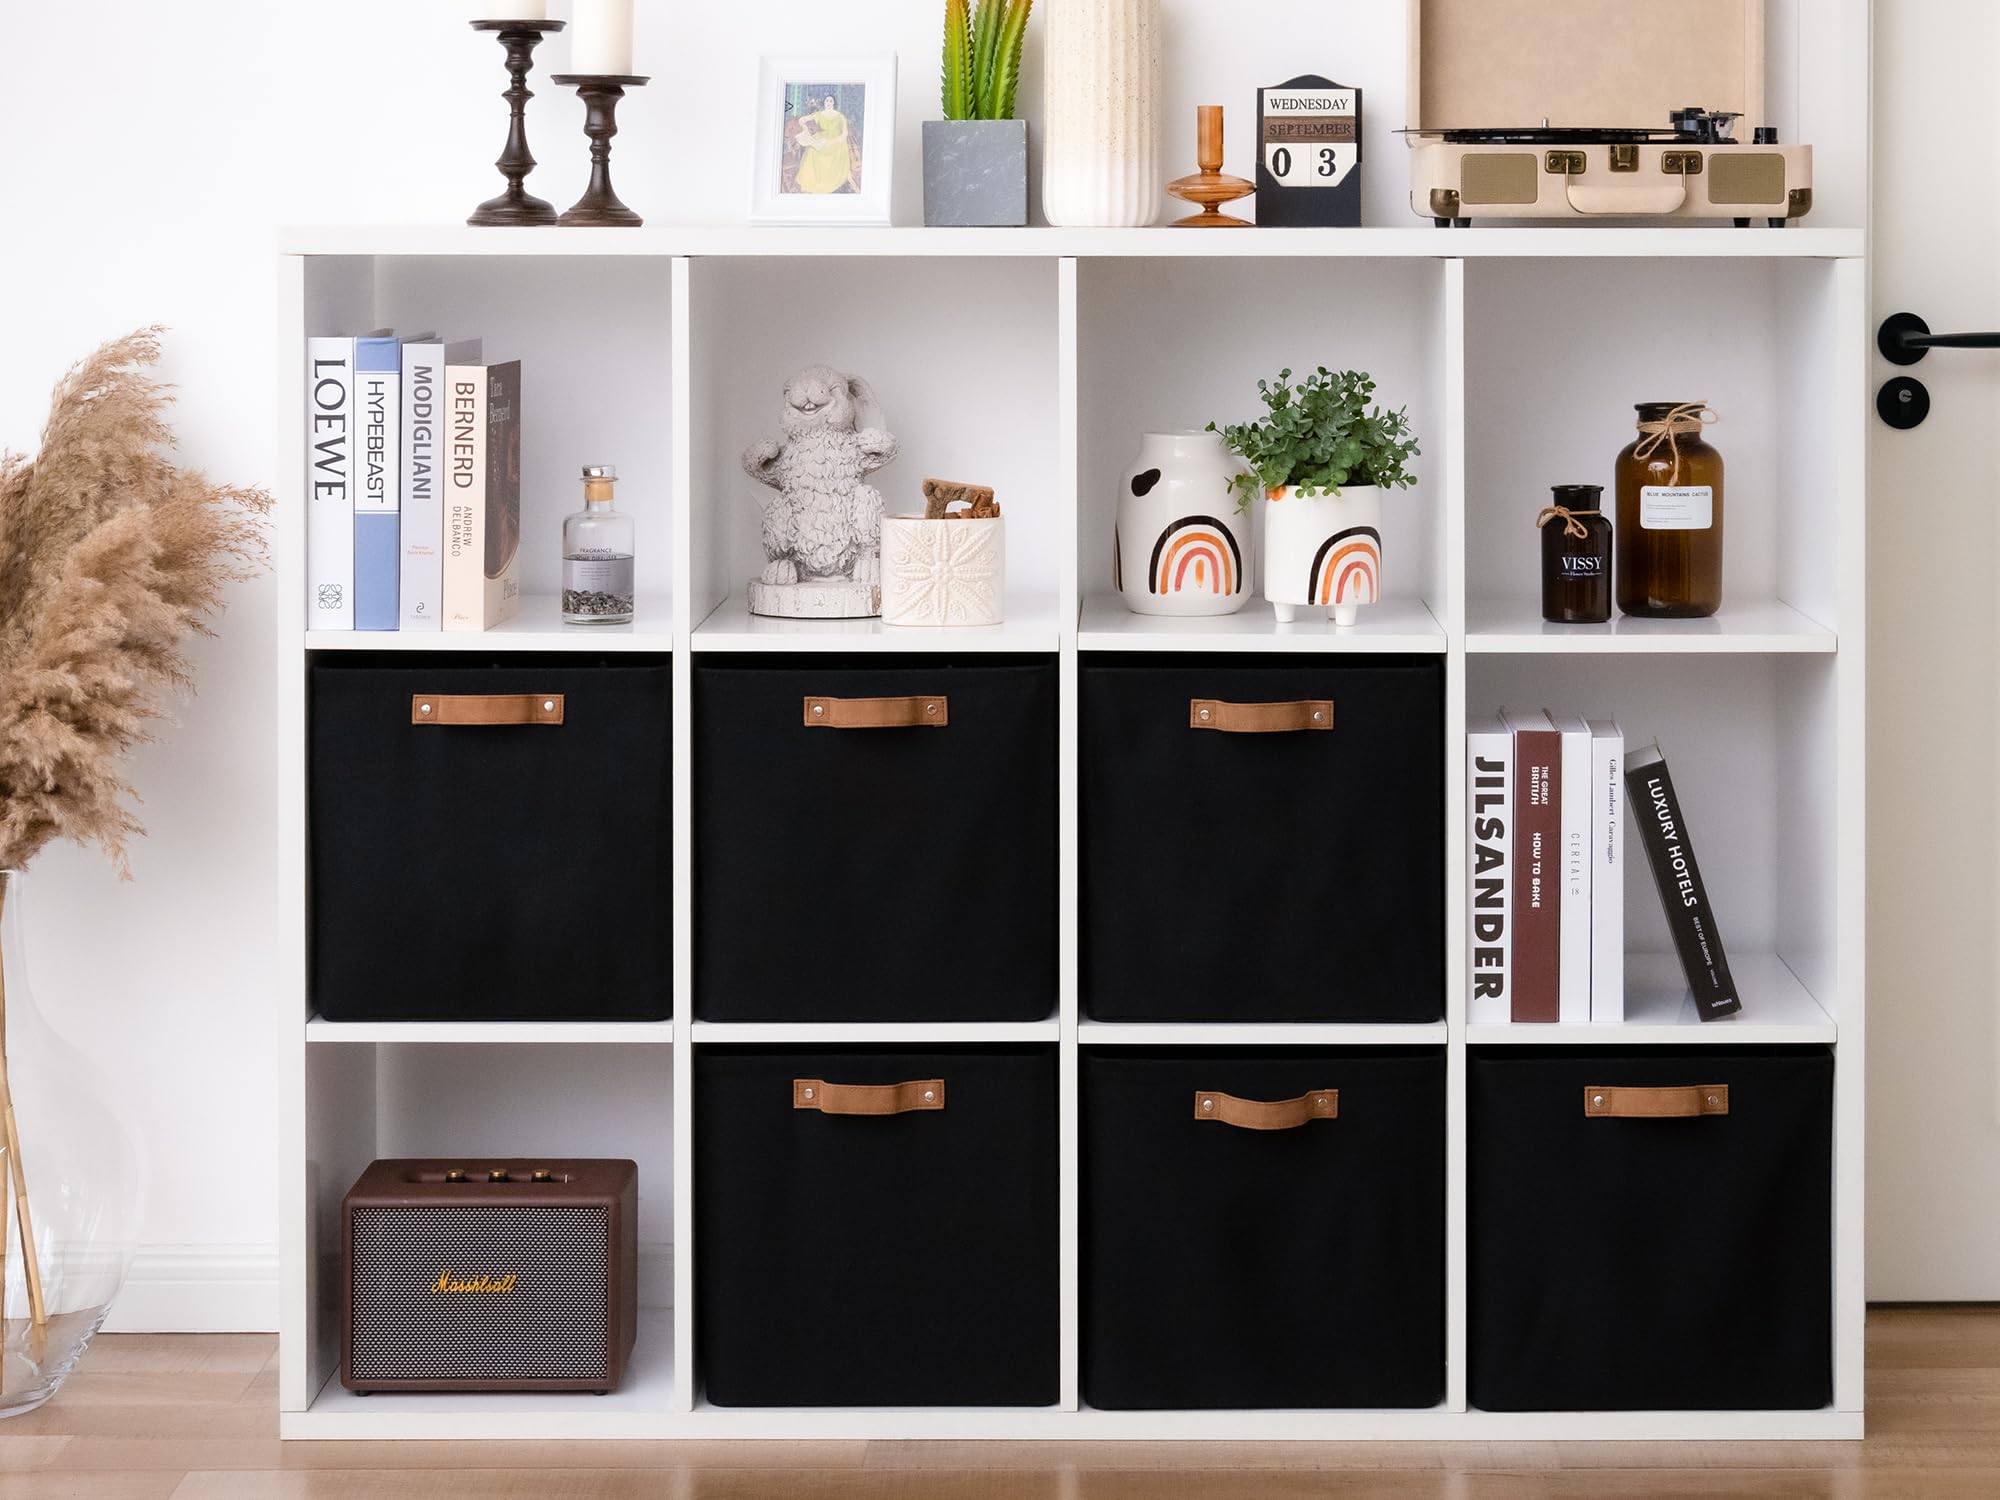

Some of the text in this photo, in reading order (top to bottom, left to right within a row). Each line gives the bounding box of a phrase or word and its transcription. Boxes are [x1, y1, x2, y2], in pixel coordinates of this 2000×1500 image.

[1270, 98, 1348, 110] WEDNESDAY
[1269, 123, 1352, 136] SEPTEMBER
[1272, 147, 1337, 177] 0 3
[314, 358, 346, 501] LOEWE
[367, 381, 385, 503] HYPEBEAST
[412, 365, 433, 500] MODIGLIANI
[453, 382, 475, 489] BERNERD
[451, 506, 461, 557] DELBANCO
[462, 506, 473, 547] ANDREW
[1561, 556, 1602, 570] VISSY
[1530, 766, 1540, 805] BRITISH
[1540, 766, 1549, 805] THE GREAT
[1607, 759, 1617, 864] Gilles Lambert Caravaggio
[1570, 833, 1581, 882] CEREAL
[1648, 778, 1698, 907] LUXURY HOTELS
[1474, 756, 1505, 1001] JILSANDER
[1531, 832, 1542, 908] HOW TO BAKE
[1692, 916, 1712, 966] BEST OF EUROPE
